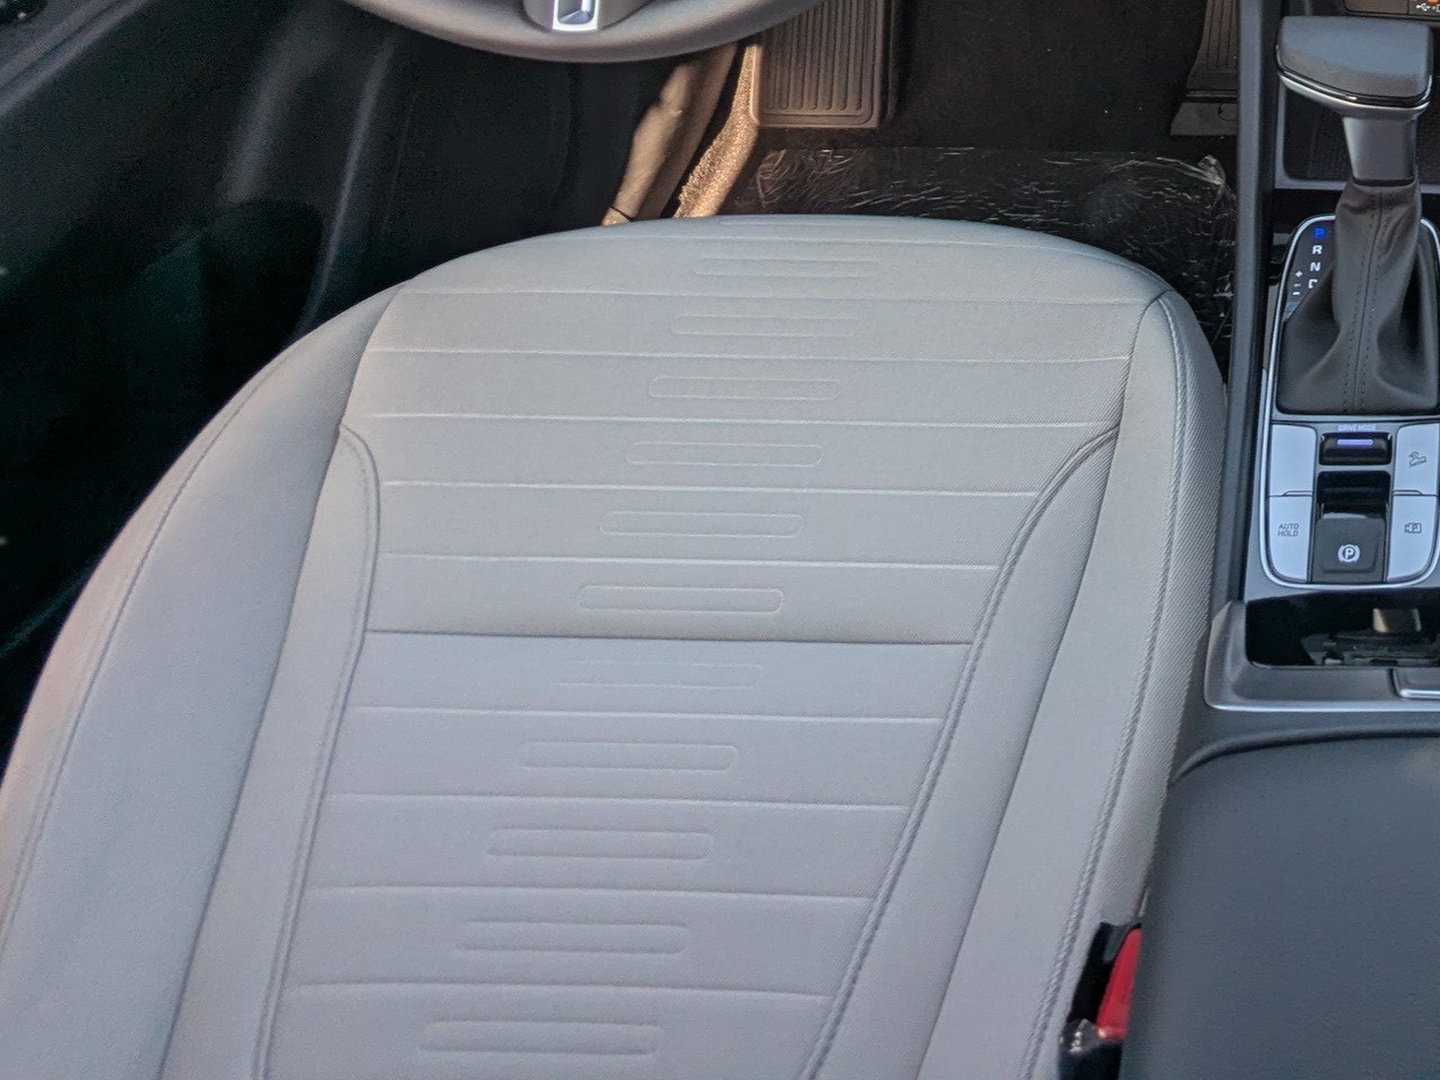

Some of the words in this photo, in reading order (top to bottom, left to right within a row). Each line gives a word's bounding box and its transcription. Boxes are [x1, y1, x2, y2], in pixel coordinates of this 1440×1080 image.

[1314, 228, 1324, 239] P
[1312, 245, 1323, 255] R
[1310, 261, 1321, 271] N
